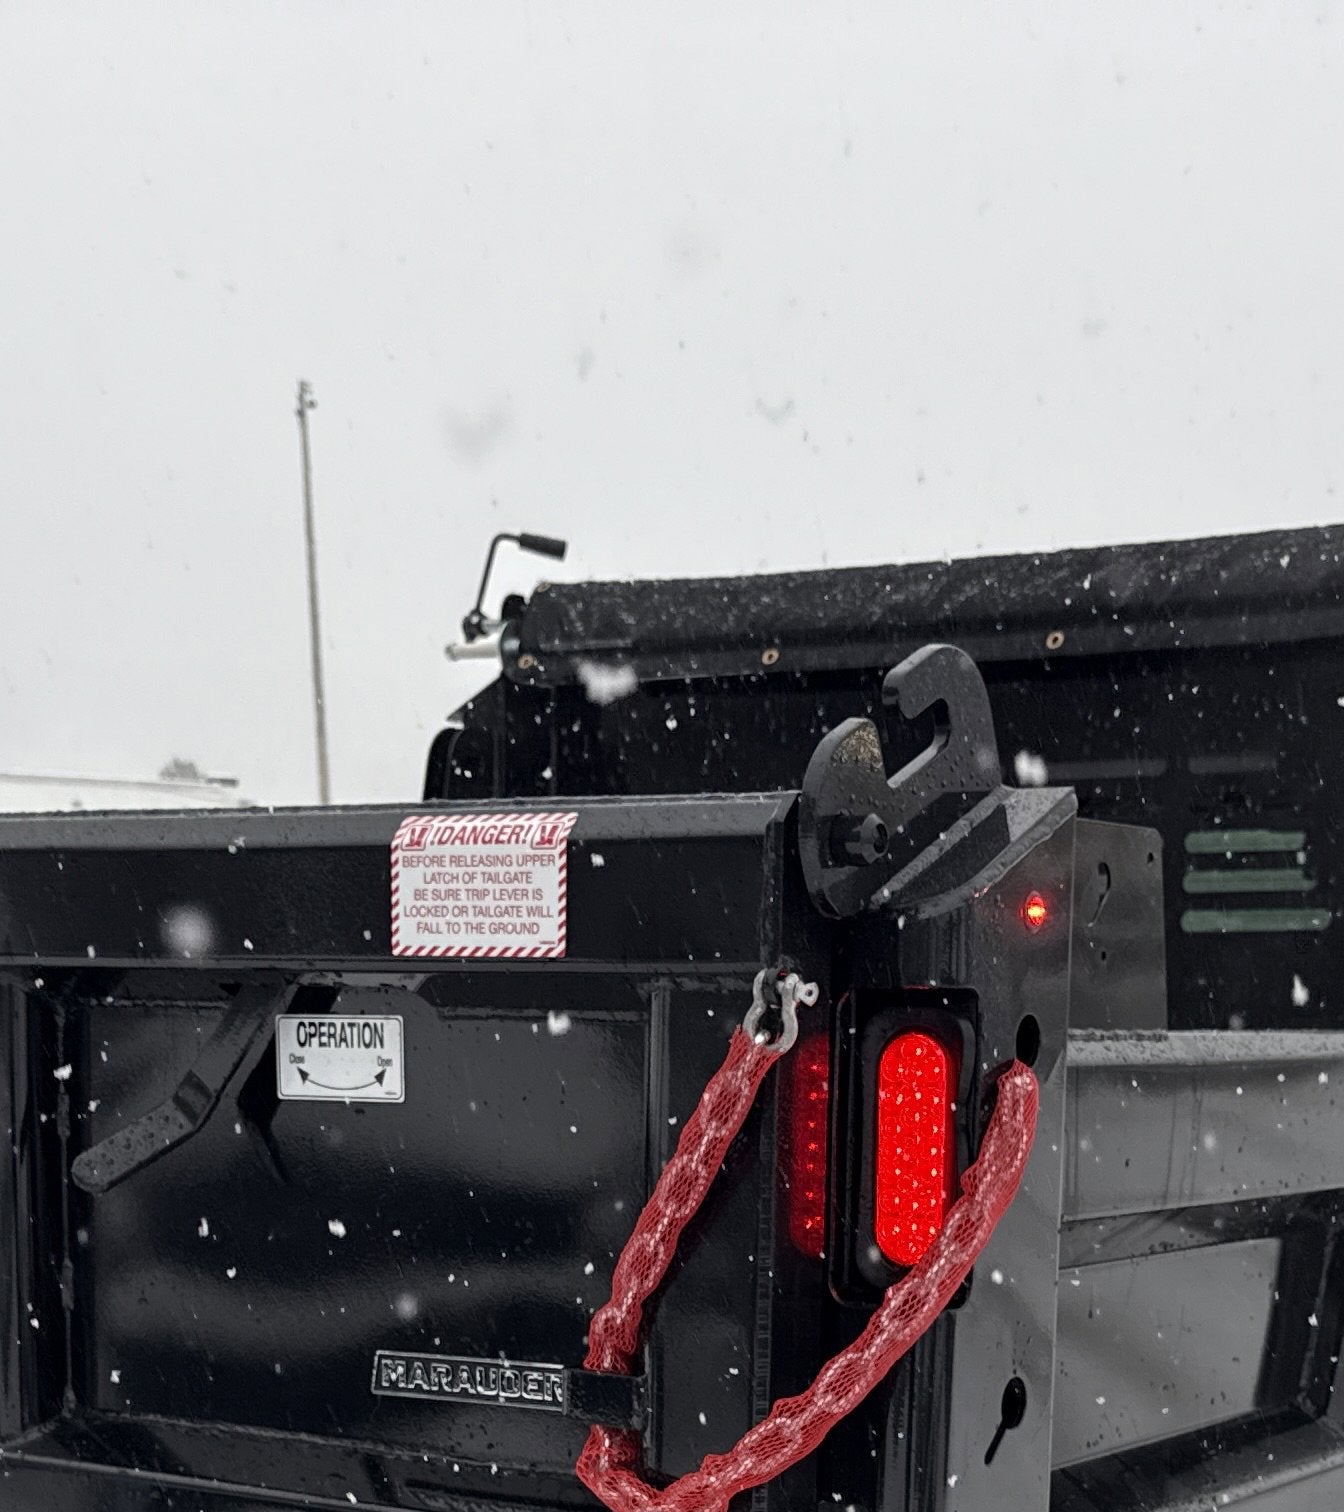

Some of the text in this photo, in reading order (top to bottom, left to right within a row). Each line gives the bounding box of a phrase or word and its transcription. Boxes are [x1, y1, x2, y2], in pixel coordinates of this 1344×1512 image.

[402, 854, 556, 868] BEFORE RELEASING UPPER
[423, 871, 533, 884] LATCH OF TAILGATE
[414, 888, 543, 901] BE SURE TRIP LEVER IS
[403, 905, 554, 918] LOCKED OR TAILGATE WILL
[416, 922, 540, 935] FALL TO THE GROUND
[296, 1021, 385, 1049] OPERATION
[377, 1055, 393, 1068] Open
[380, 1358, 564, 1403] MARAUDER
